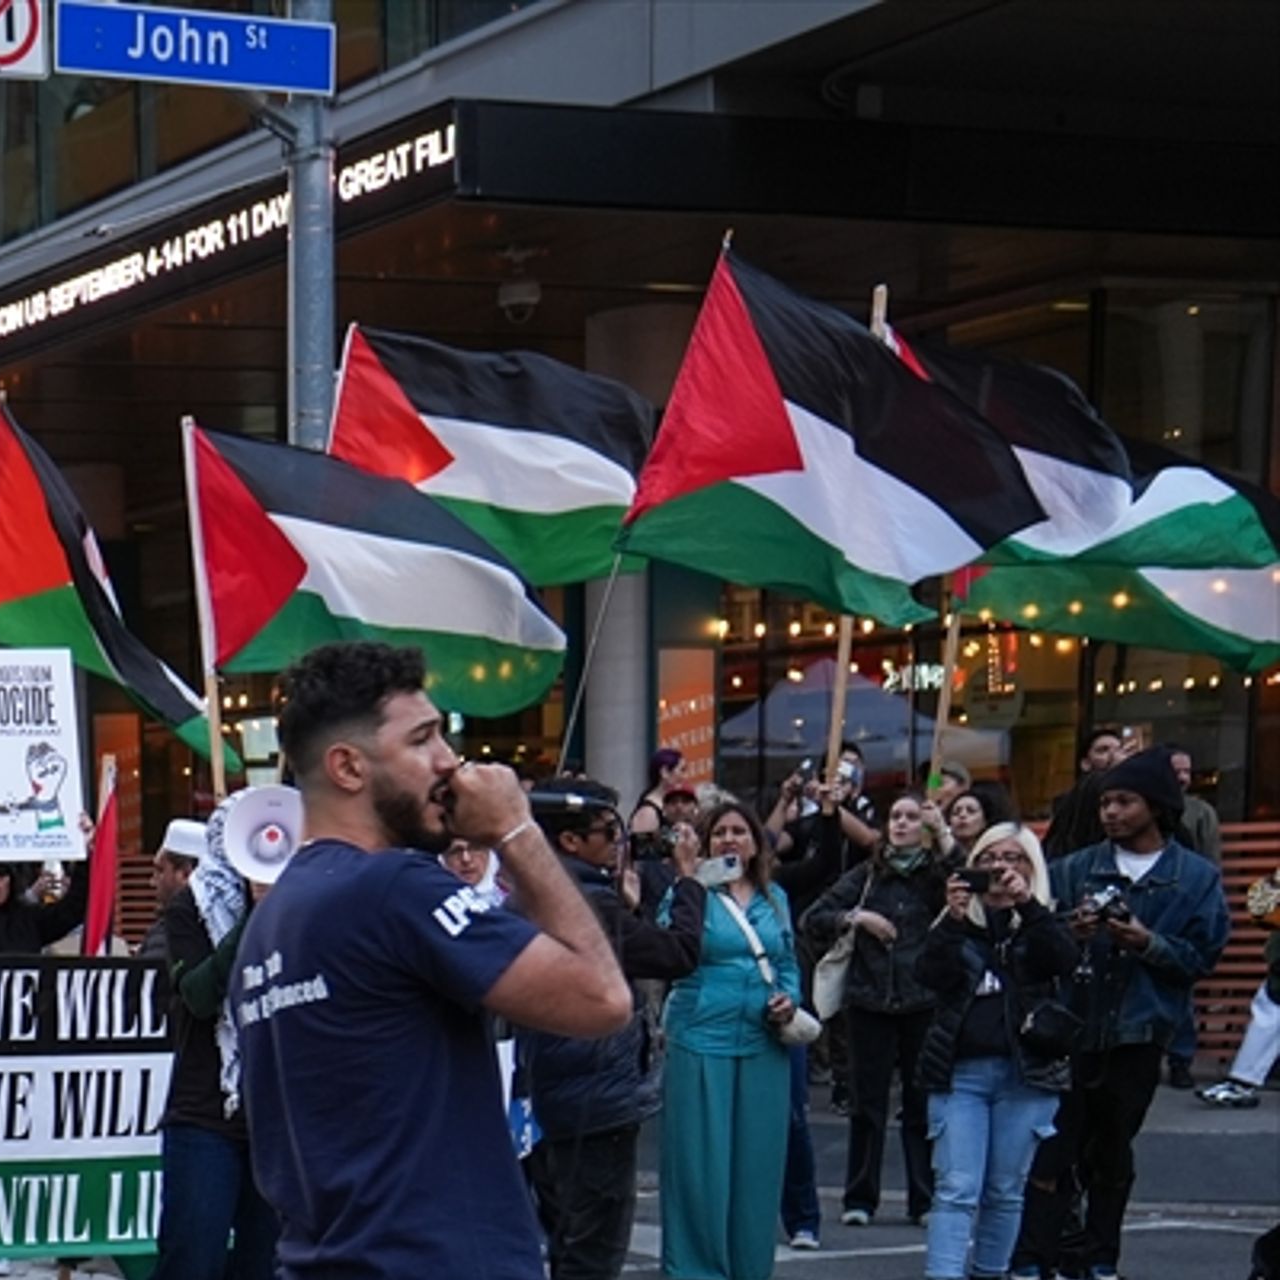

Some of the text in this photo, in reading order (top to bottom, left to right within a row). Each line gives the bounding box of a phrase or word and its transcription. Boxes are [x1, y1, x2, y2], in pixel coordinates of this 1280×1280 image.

[126, 13, 268, 66] John St
[47, 252, 145, 315] SEPTEMBER
[146, 237, 183, 276] 4-14
[184, 220, 225, 263] FOR
[227, 209, 248, 245] 11
[339, 141, 414, 201] GREAT
[56, 968, 168, 1040] WILL
[52, 1068, 159, 1139] WILL
